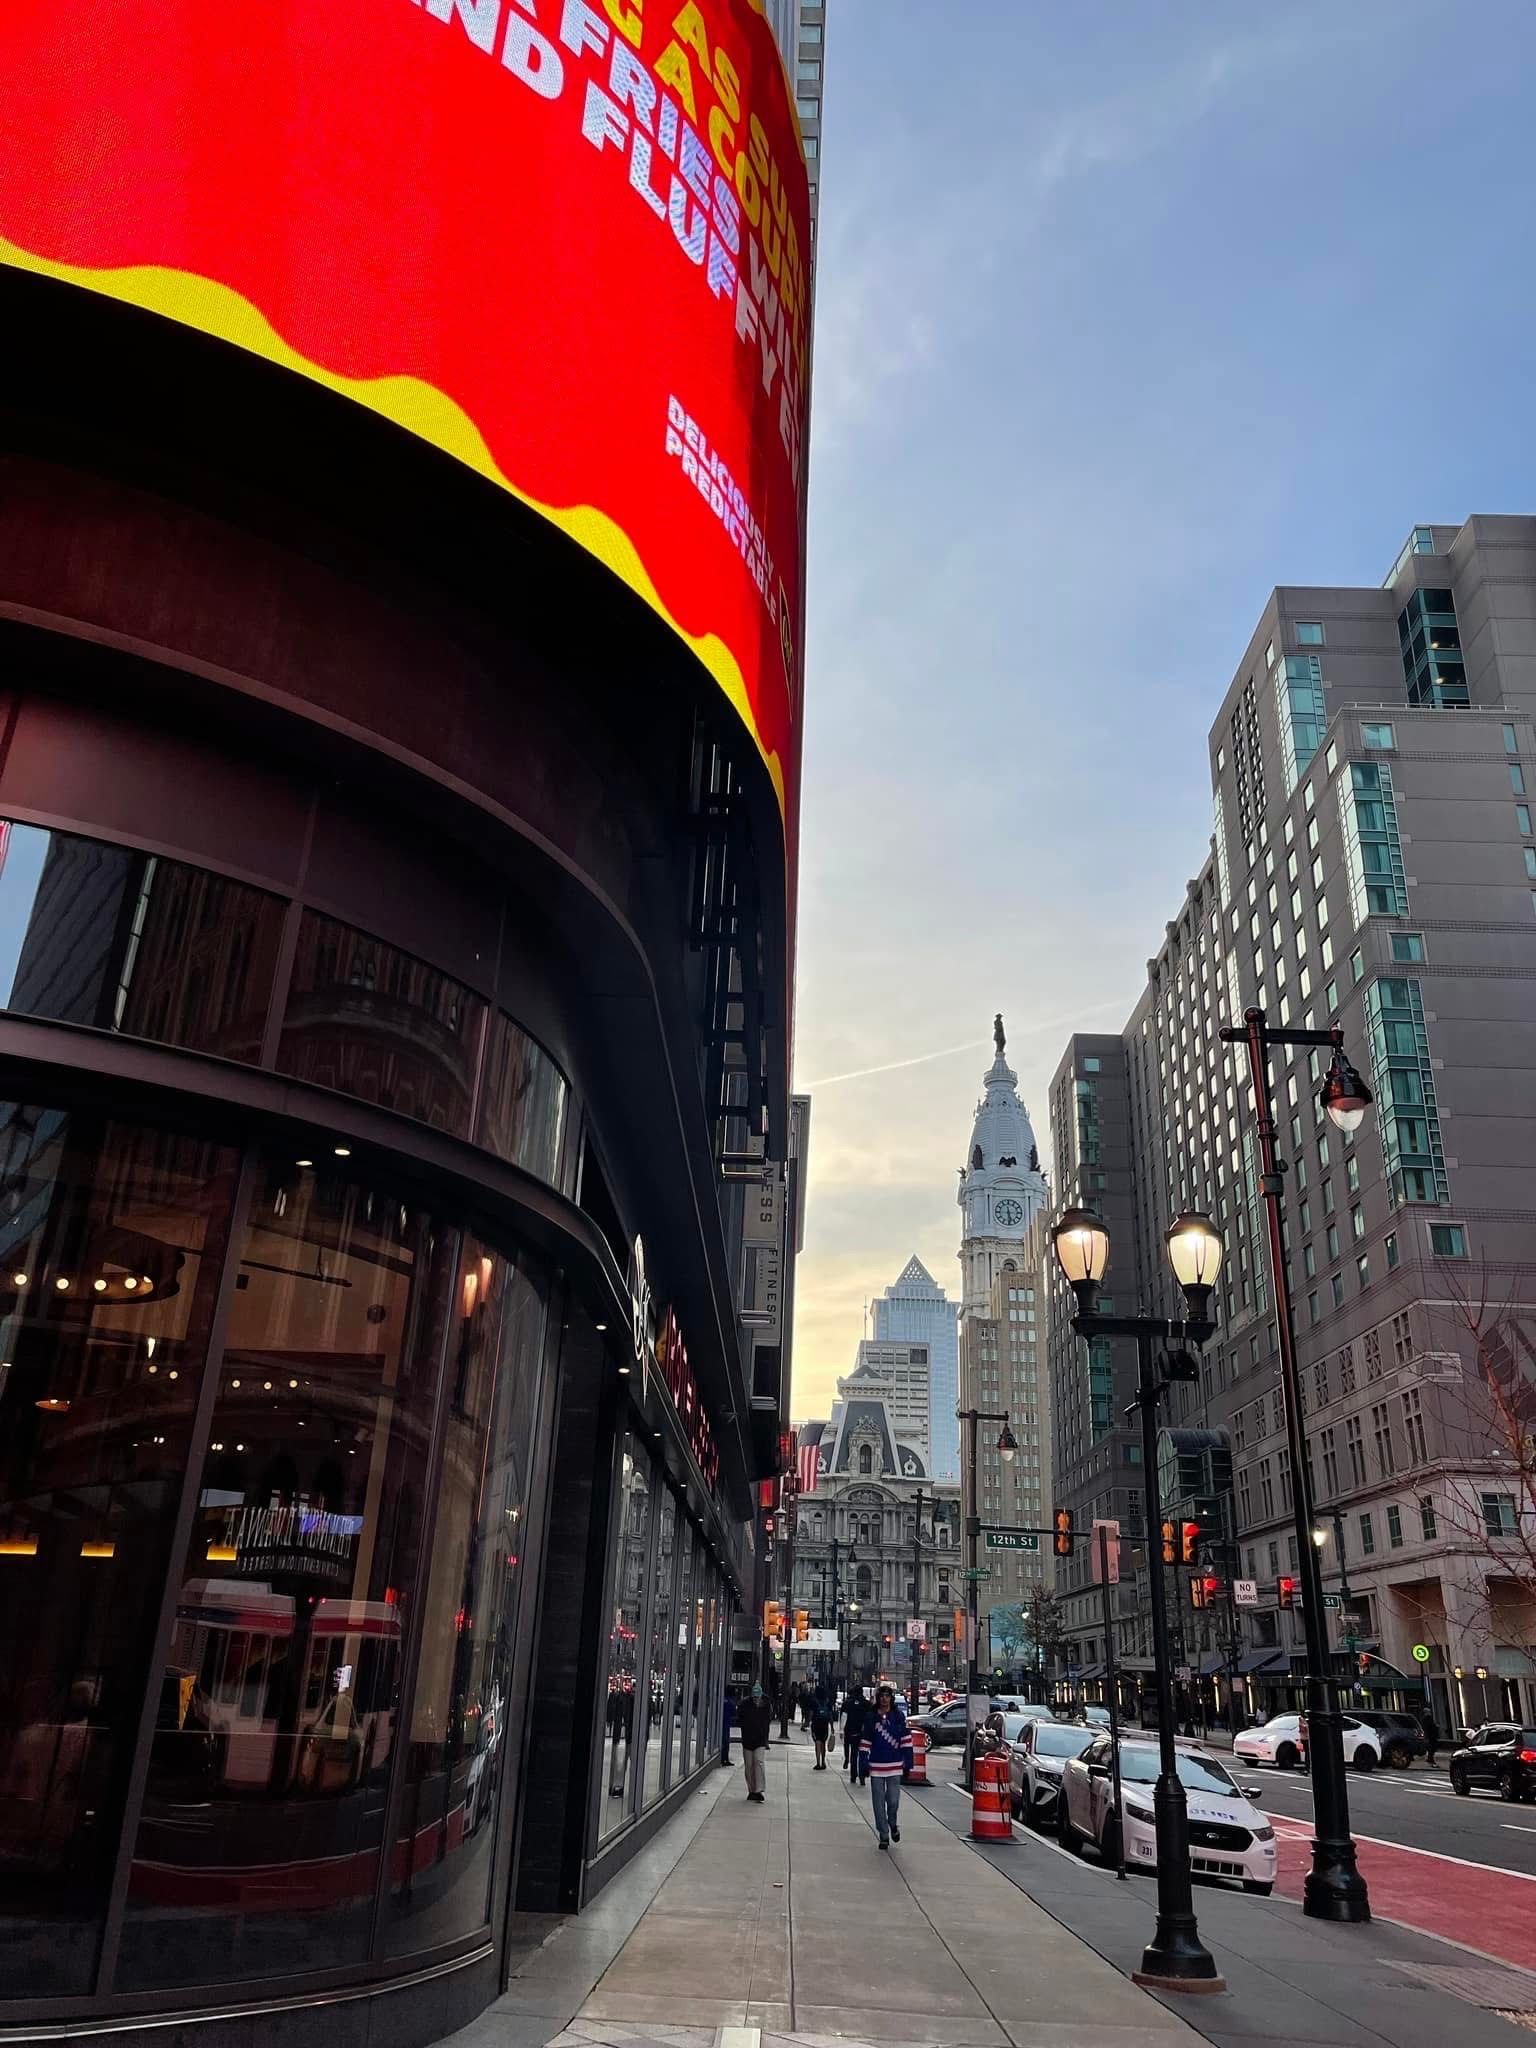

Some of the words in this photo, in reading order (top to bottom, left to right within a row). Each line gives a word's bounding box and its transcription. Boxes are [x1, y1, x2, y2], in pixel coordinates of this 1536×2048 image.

[559, 0, 740, 256] FRIES
[653, 39, 698, 126] A
[672, 0, 740, 124] AS
[408, 0, 565, 100] ND
[581, 79, 778, 399] FLUFFY
[665, 423, 777, 626] PREDICTABLE
[668, 393, 775, 582] DELICIOUSLY
[992, 1535, 1016, 1545] 12th
[1021, 1536, 1033, 1546] St
[1239, 1583, 1251, 1592] NO
